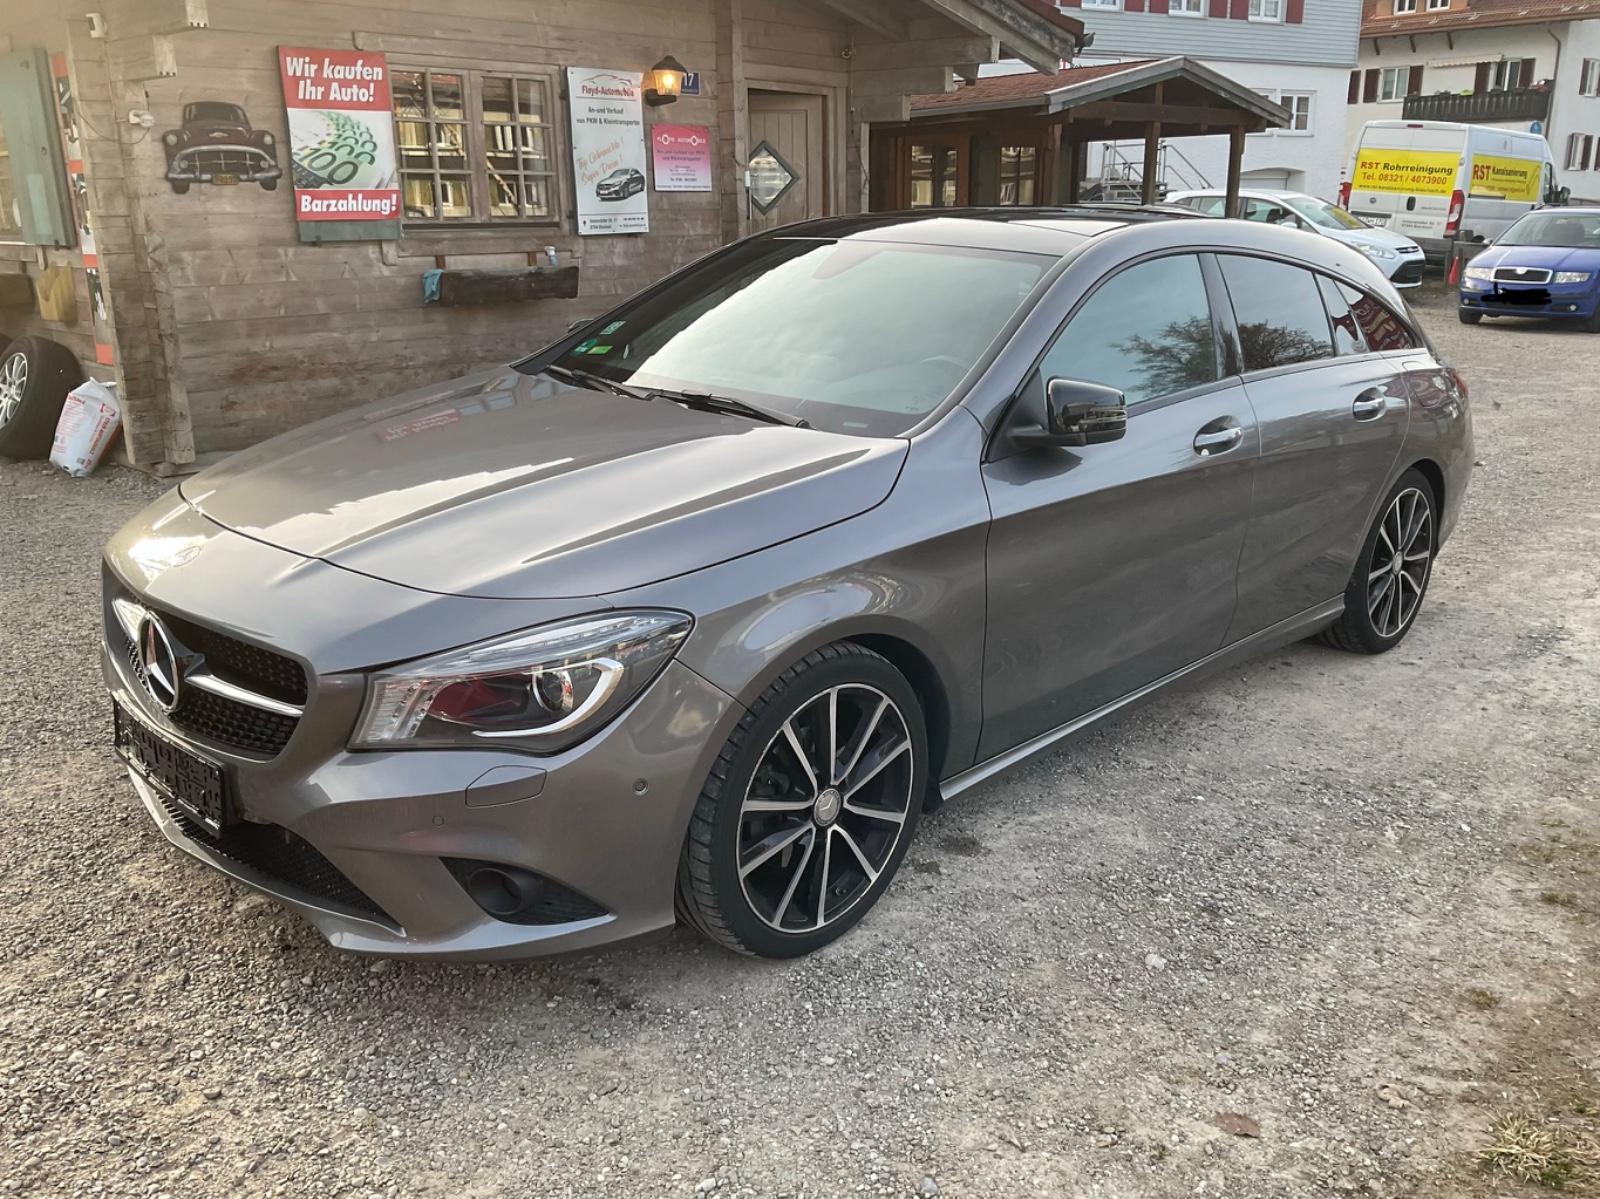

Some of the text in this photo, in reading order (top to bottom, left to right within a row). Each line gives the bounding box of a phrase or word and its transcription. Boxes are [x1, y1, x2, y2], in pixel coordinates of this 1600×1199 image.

[286, 57, 383, 80] Wir kaufen
[683, 73, 694, 87] 17
[298, 79, 374, 102] Ihr Auto!
[1360, 161, 1453, 176] RST Rohrreinigung
[1472, 164, 1491, 181] RST
[1363, 172, 1375, 181] Tel.
[1379, 173, 1403, 182] 08321
[1411, 175, 1447, 185] 4073900
[301, 193, 397, 215] Barzahlung!
